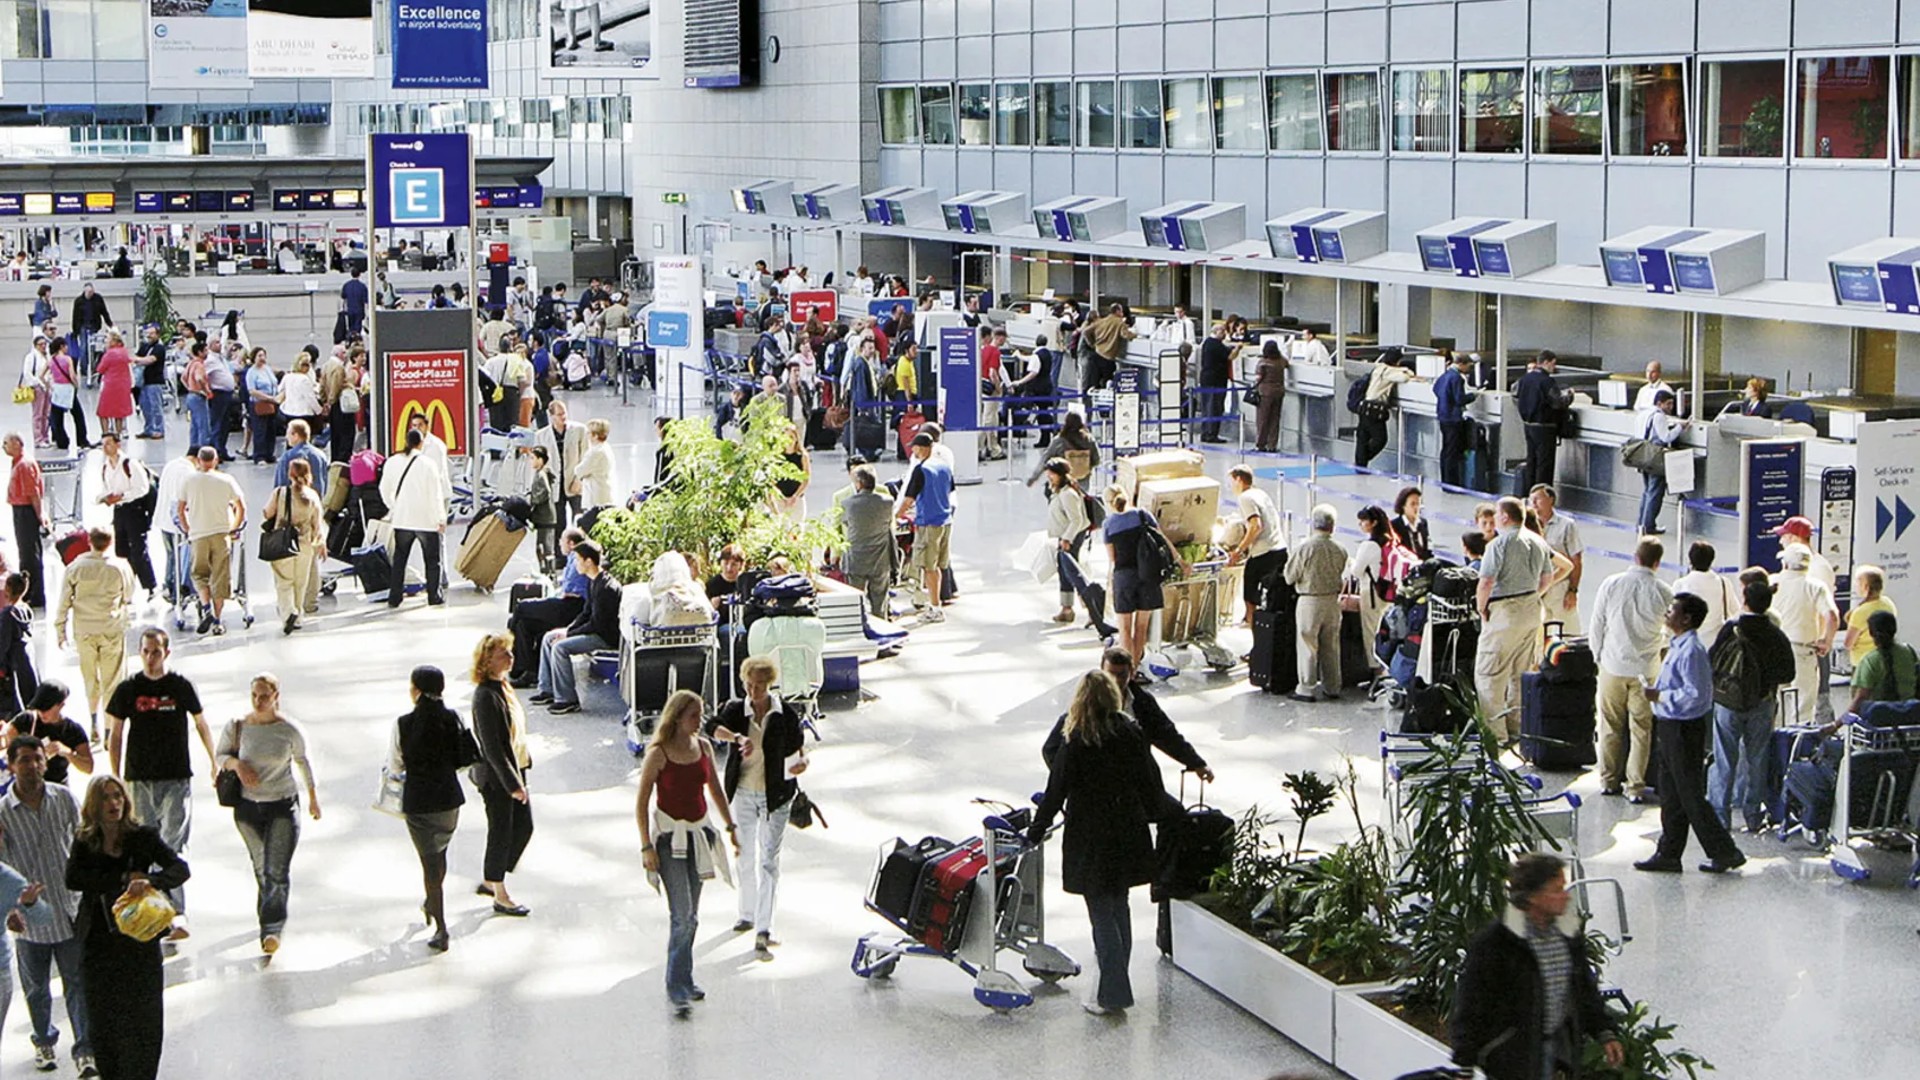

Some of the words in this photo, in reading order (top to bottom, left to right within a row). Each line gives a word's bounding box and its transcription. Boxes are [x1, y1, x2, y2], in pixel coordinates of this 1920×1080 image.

[399, 5, 481, 20] Excellence
[408, 20, 435, 30] airport
[437, 21, 482, 31] advertising
[254, 39, 276, 49] ABU
[279, 39, 315, 49] DHABI
[406, 179, 429, 212] E
[393, 359, 406, 370] Up
[408, 359, 430, 368] here
[432, 359, 442, 367] at
[444, 358, 459, 367] the
[393, 369, 457, 379] Food-Plaza!
[1873, 466, 1914, 476] Self-Service
[1880, 478, 1909, 487] Check-in
